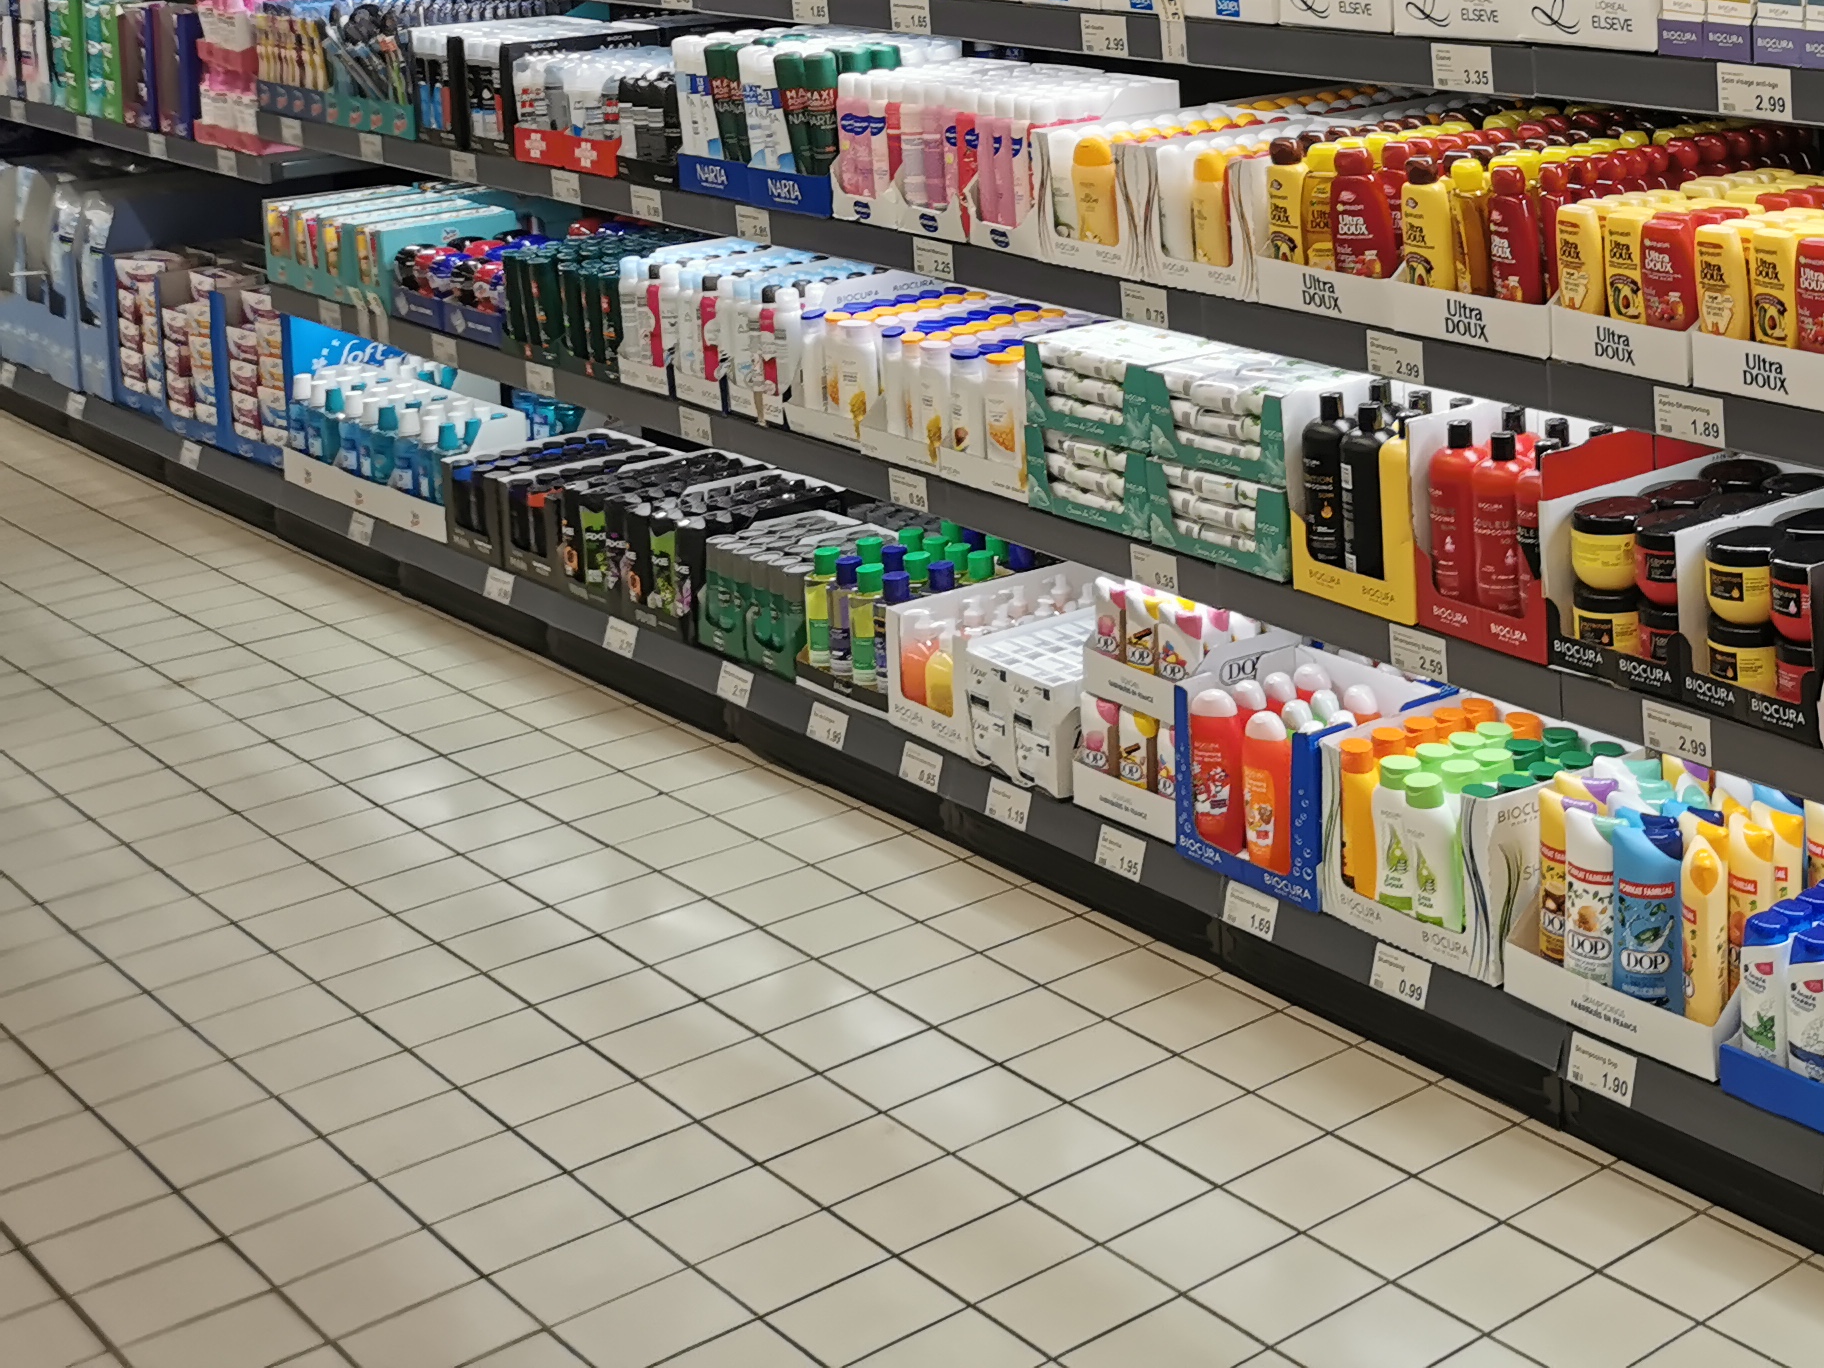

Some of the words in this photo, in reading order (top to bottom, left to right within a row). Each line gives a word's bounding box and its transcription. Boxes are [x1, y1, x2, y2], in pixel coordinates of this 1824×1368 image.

[1591, 13, 1634, 33] ELSEVE
[1105, 36, 1125, 51] 2.99
[1463, 68, 1489, 85] 3.35
[1755, 95, 1786, 113] 2.99
[1396, 361, 1420, 378] 2.99
[1745, 353, 1783, 375] Ultra
[1742, 370, 1788, 395] DOUX
[1691, 419, 1719, 440] 1.89
[1751, 698, 1805, 728] BIOCURA
[1120, 854, 1139, 874] 1.95
[1621, 948, 1668, 972] DOP
[1399, 979, 1424, 1001] 0.99
[1602, 1072, 1629, 1096] 1.90
